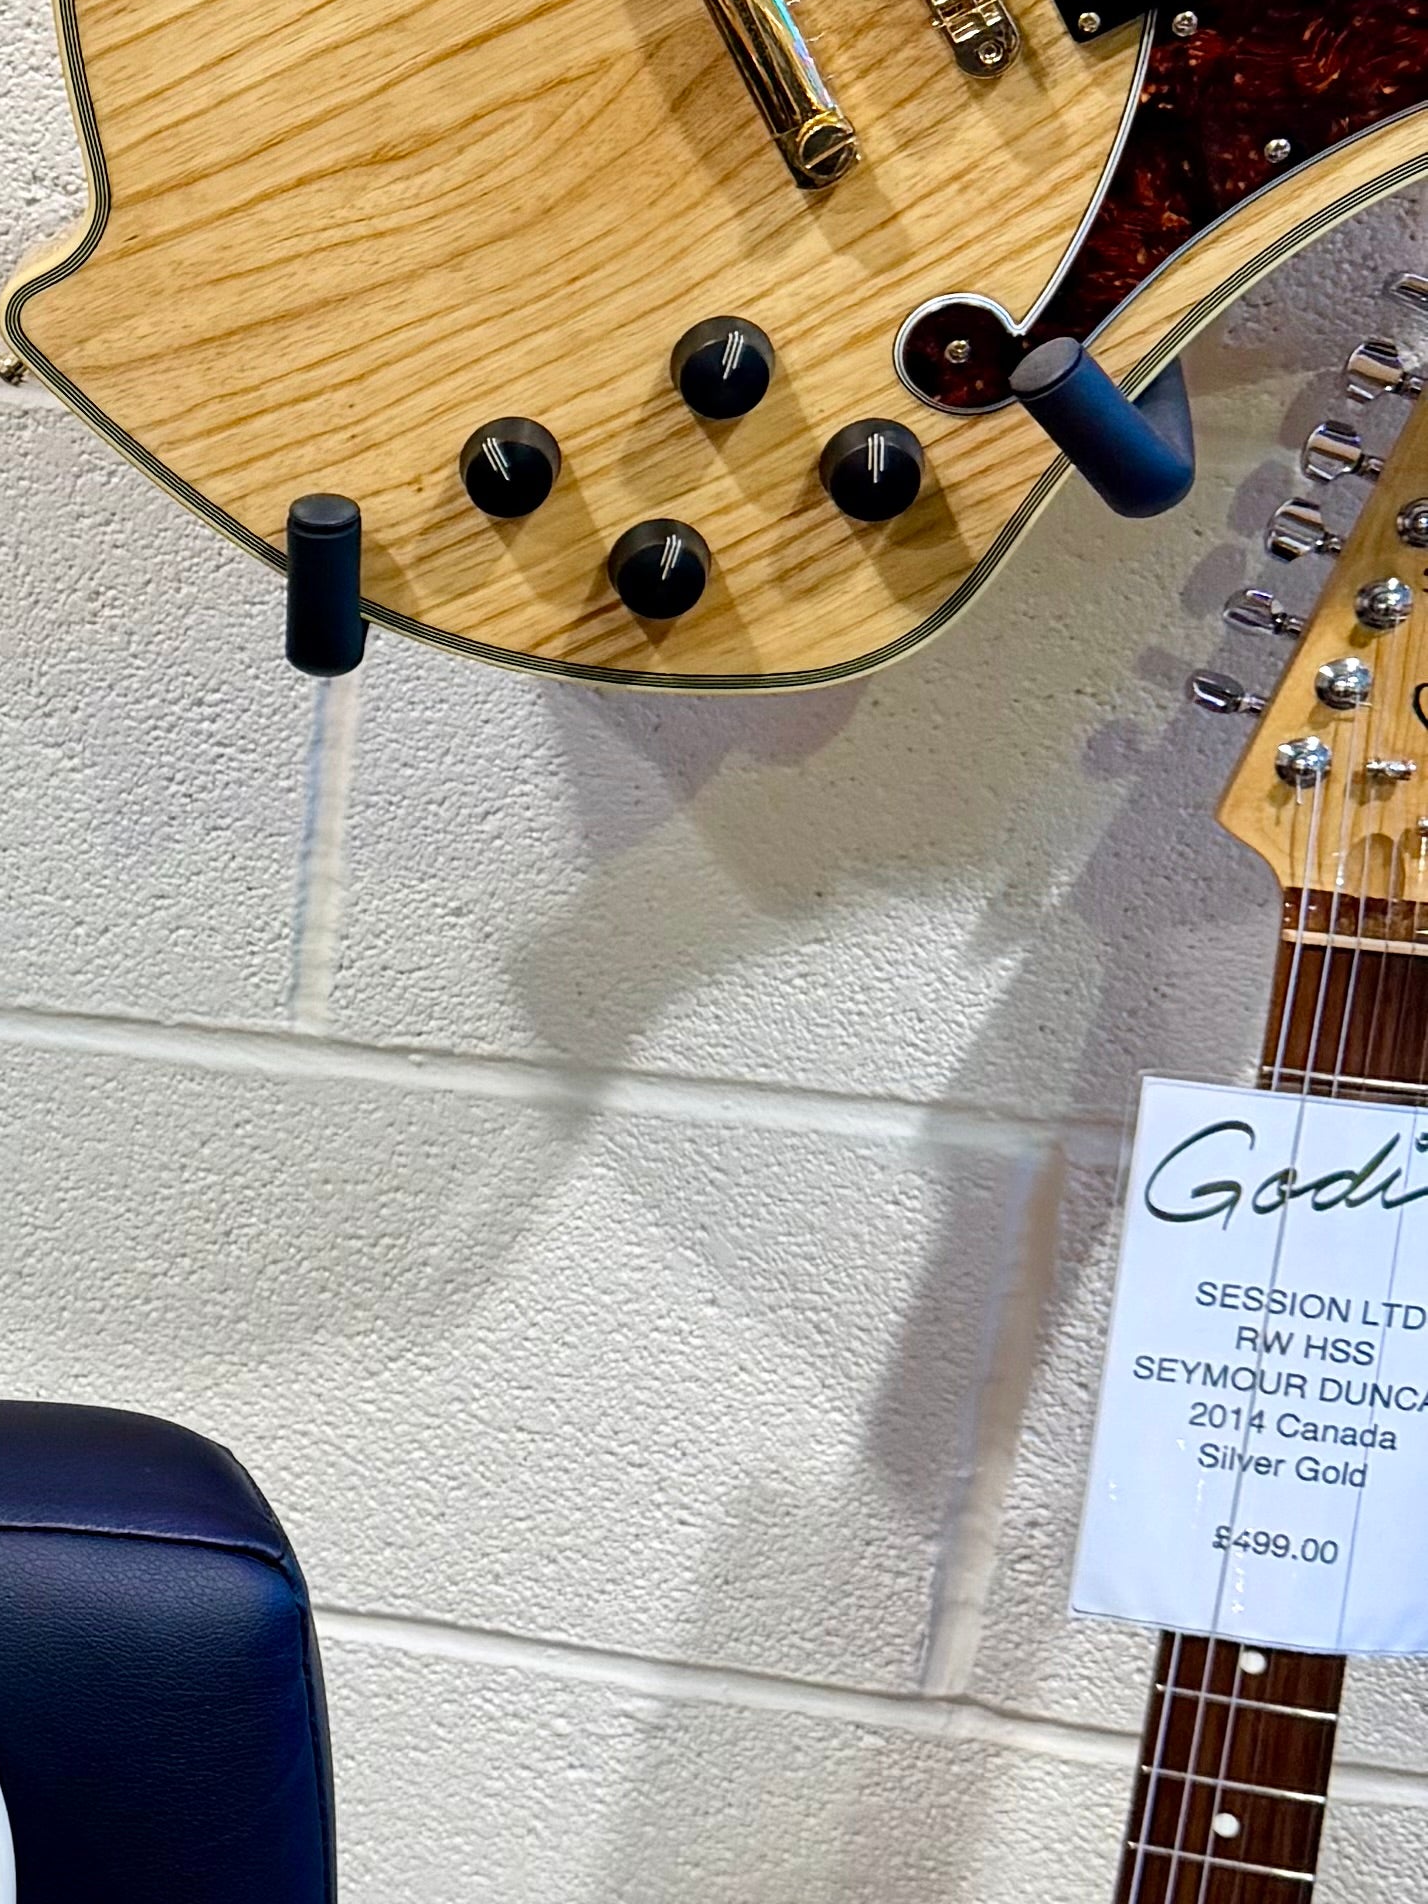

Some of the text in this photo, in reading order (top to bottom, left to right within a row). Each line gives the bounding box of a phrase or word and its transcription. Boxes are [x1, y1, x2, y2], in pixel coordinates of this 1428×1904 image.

[1195, 1280, 1427, 1331] SESSION LTD
[1236, 1326, 1376, 1367] RW HSS
[1132, 1355, 1308, 1399] SEYMOUR
[1188, 1402, 1398, 1452] 2014 Canada
[1198, 1443, 1369, 1489] Silver Gold
[1211, 1525, 1339, 1566] £499.00
